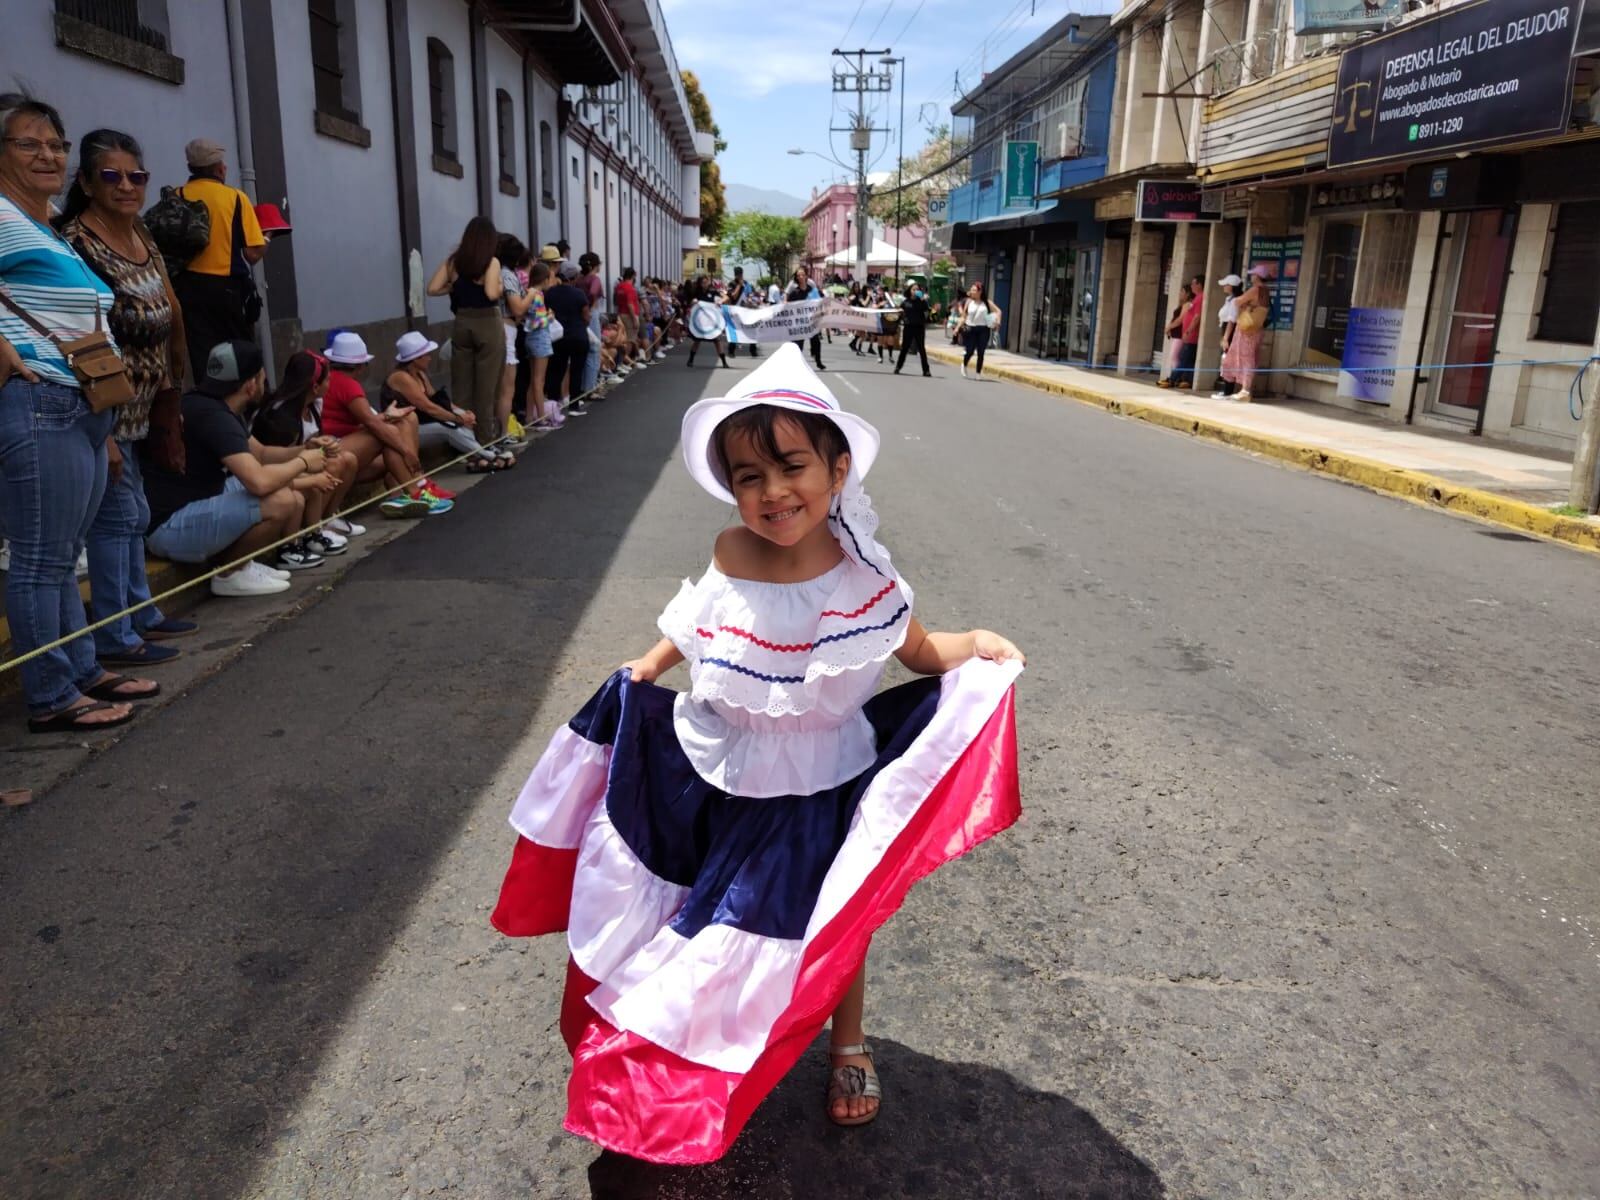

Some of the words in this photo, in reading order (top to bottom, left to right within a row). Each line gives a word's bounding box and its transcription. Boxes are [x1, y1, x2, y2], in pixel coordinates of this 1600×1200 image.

[1385, 47, 1434, 79] DEFENSA
[1436, 35, 1474, 64] LEGAL
[1477, 26, 1503, 52] DEL
[1506, 6, 1570, 44] DEUDOR
[1382, 79, 1419, 101] Abogado
[1420, 76, 1427, 90] &
[1428, 68, 1462, 87] Notario
[1379, 78, 1520, 122] www.abogadosdecostarica.com
[1418, 116, 1464, 138] 8911-1290
[930, 200, 948, 213] OP
[1161, 188, 1200, 201] airbnb
